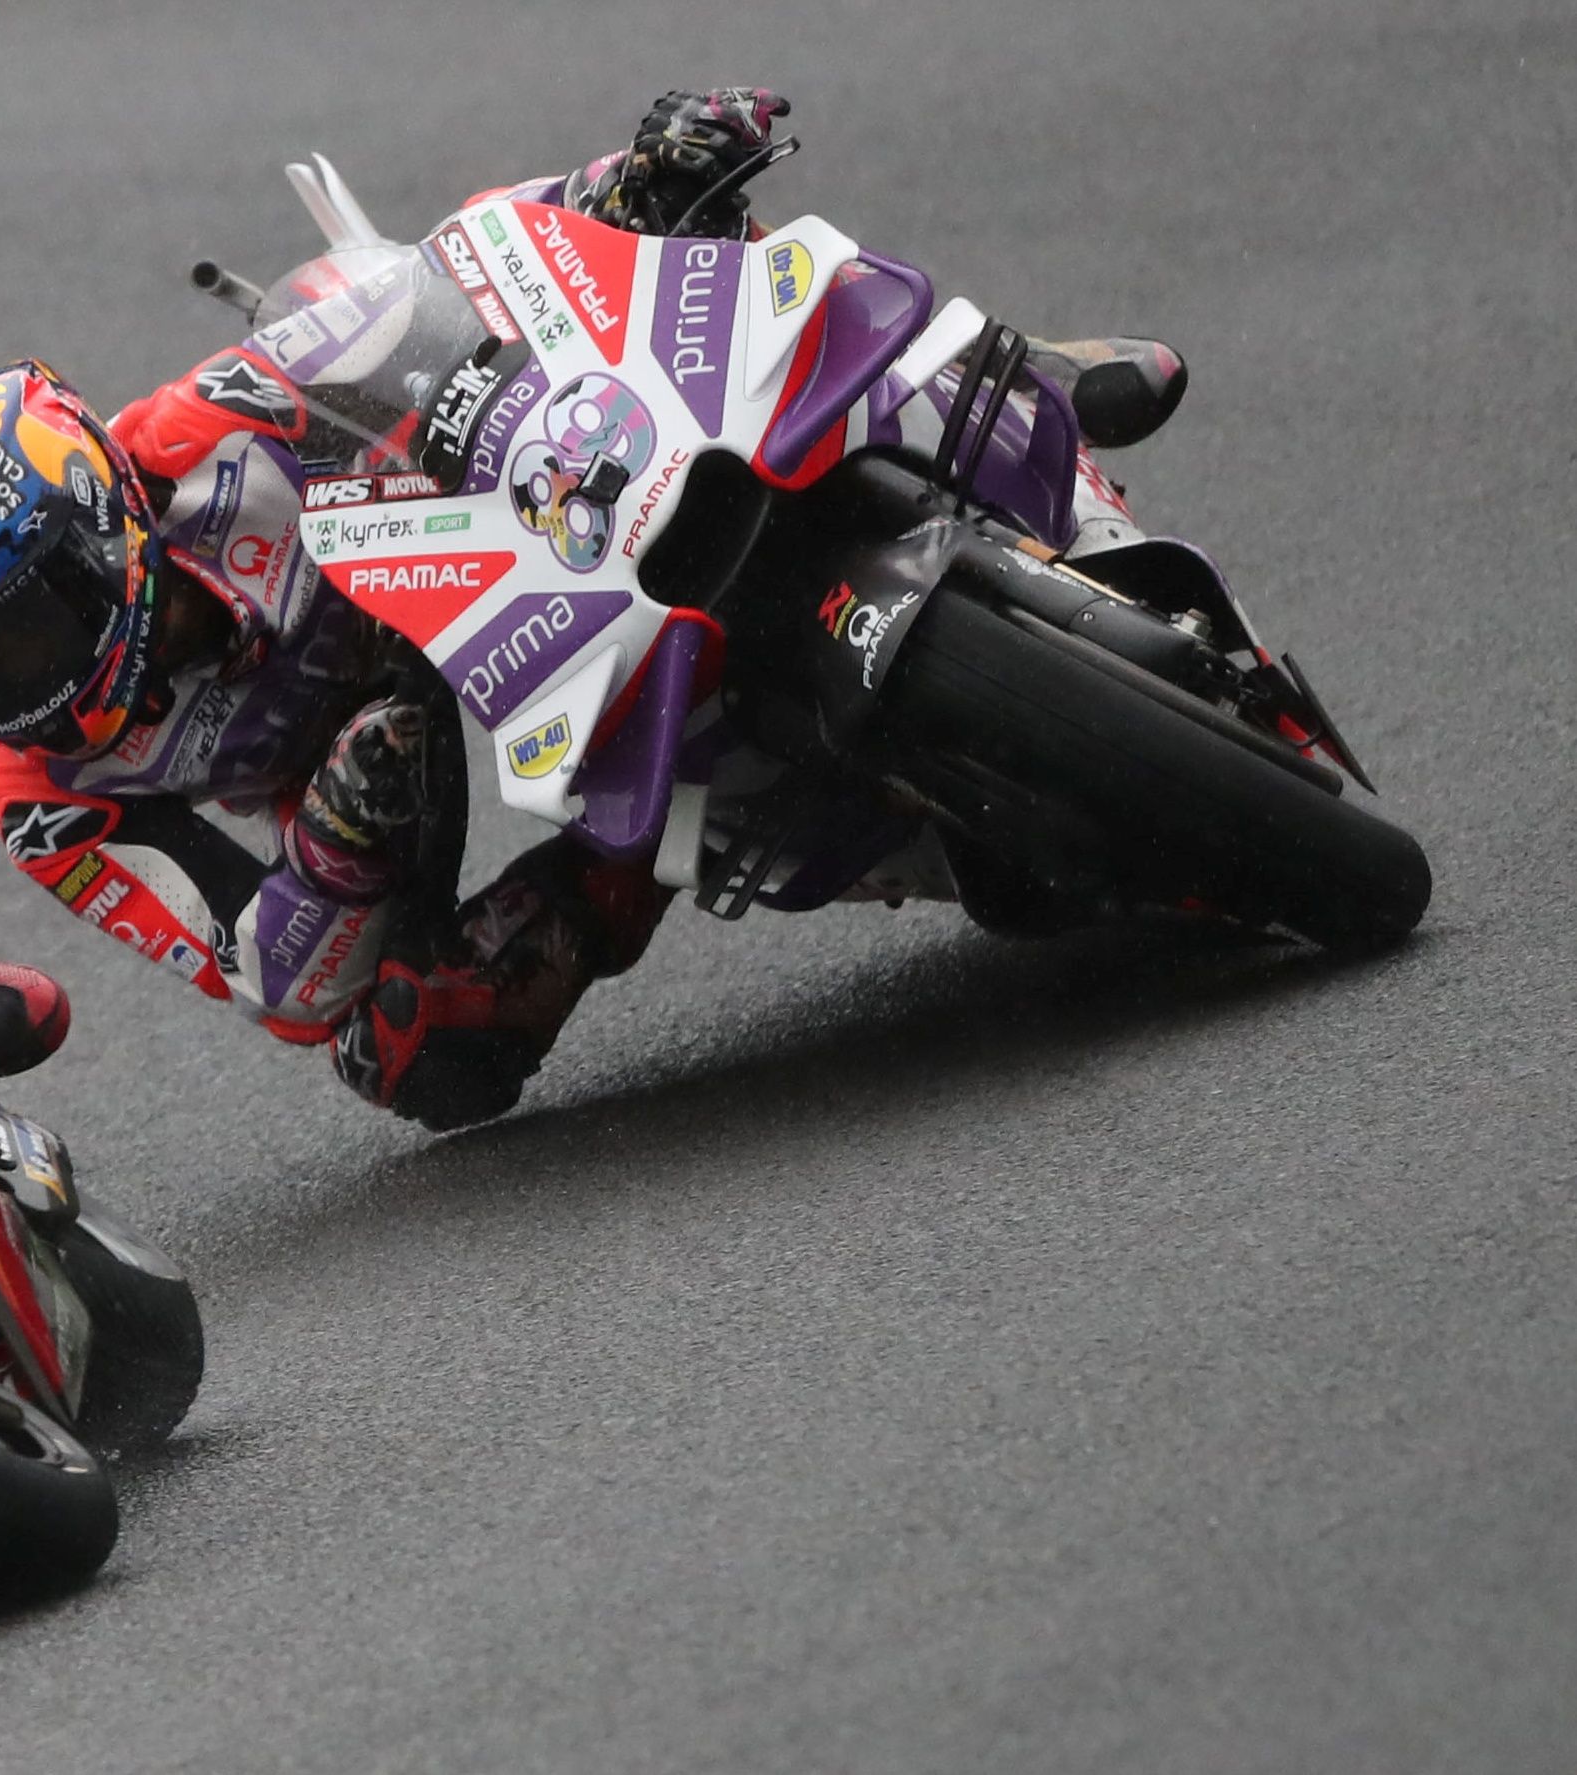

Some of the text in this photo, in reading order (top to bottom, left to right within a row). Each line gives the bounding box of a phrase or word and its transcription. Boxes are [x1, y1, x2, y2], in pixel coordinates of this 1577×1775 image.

[438, 231, 488, 289] WRS
[501, 246, 550, 323] kyrrex
[534, 211, 619, 333] PRAMAC
[772, 246, 798, 308] WD-40
[475, 292, 518, 342] MOTUL
[673, 244, 718, 385] prima
[474, 381, 535, 478] prima
[94, 476, 110, 531] Wispr
[305, 478, 373, 507] WRS
[383, 474, 439, 497] MOTUL
[622, 448, 689, 558] PRAMAC
[341, 516, 465, 548] kyrrex SPORT
[264, 521, 298, 606] PRAMAC
[350, 562, 482, 595] PRAMAC
[461, 595, 574, 715] prima
[863, 591, 920, 690] PRAMAC
[513, 721, 567, 767] WD-40
[88, 881, 131, 924] OTUL
[270, 899, 323, 969] prima
